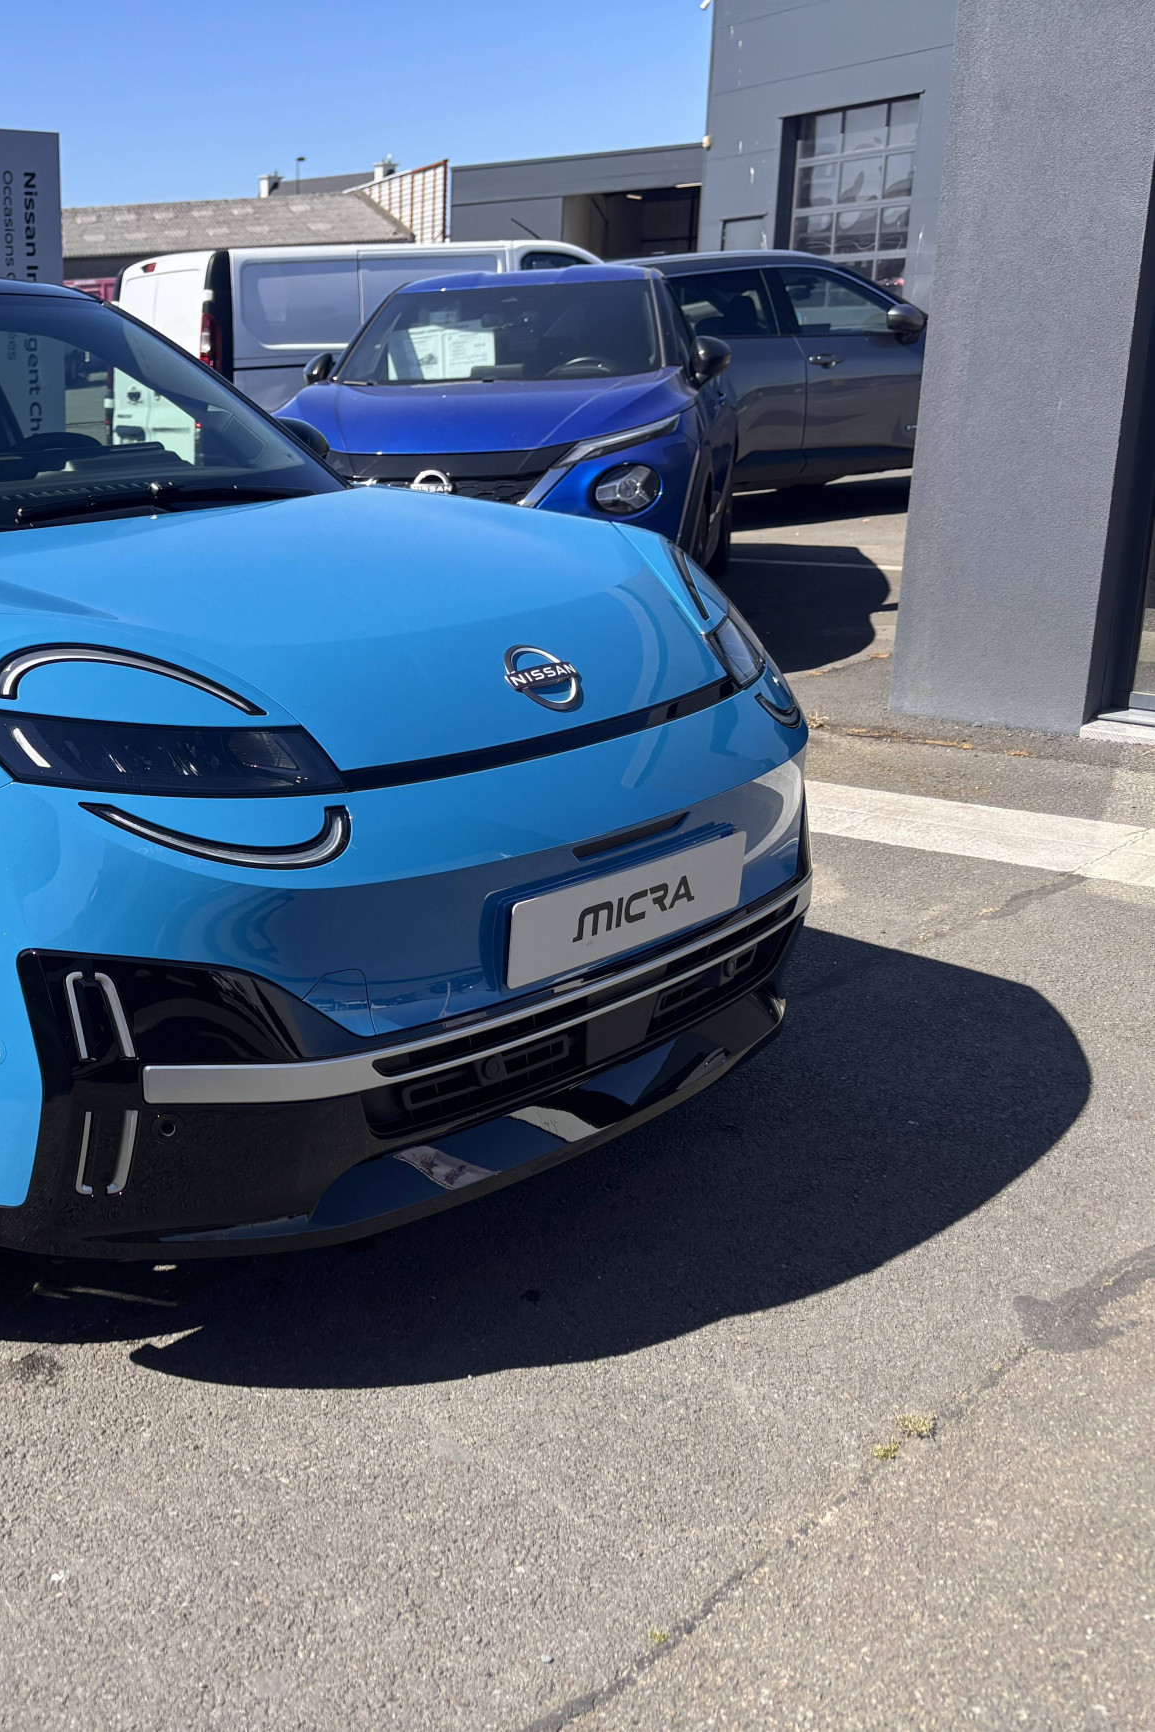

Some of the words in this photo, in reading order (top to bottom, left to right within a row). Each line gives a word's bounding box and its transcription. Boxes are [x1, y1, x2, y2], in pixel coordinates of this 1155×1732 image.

[1, 170, 16, 267] Occasions
[23, 171, 38, 257] Nissan
[509, 663, 577, 687] NISSAN
[572, 875, 695, 943] MICRA
